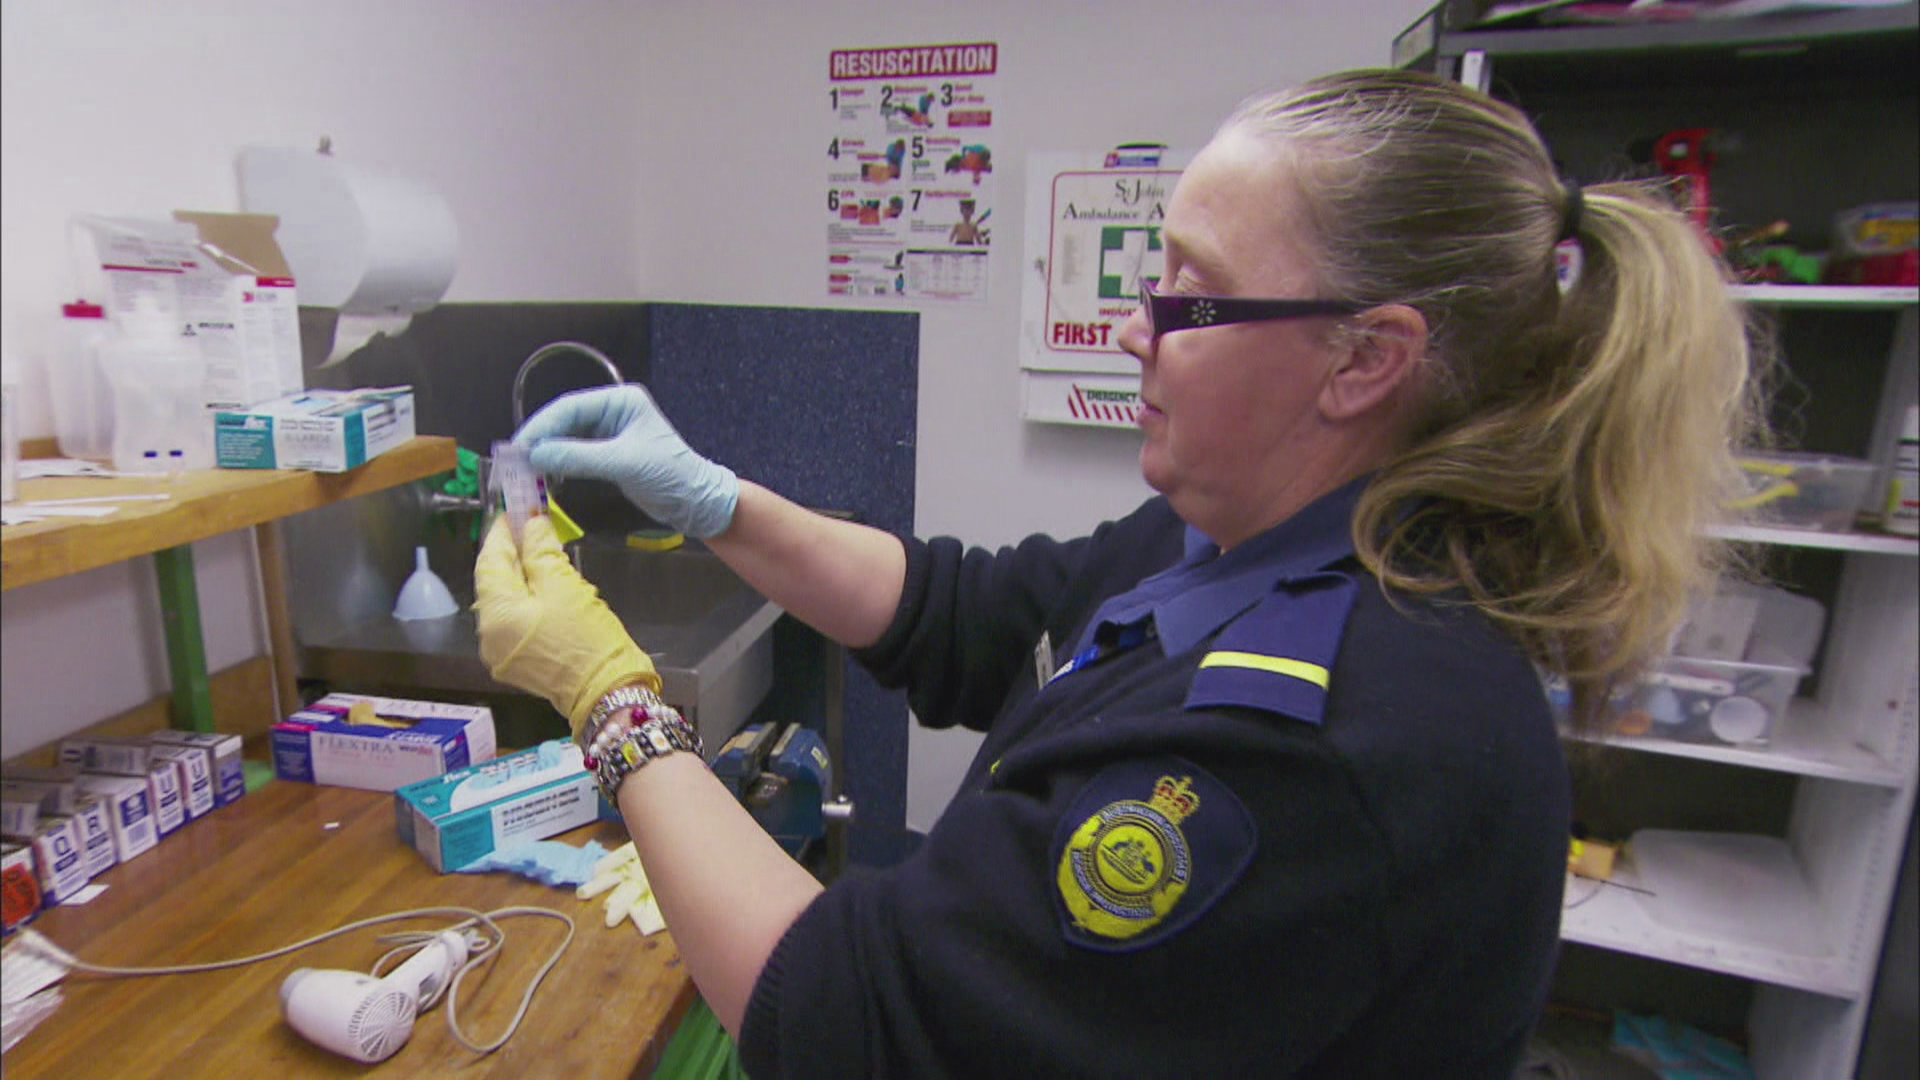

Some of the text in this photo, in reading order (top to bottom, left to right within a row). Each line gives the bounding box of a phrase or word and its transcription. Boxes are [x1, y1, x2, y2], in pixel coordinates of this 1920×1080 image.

[832, 45, 992, 77] RESUSCITATION
[830, 87, 838, 110] 1
[881, 85, 893, 110] 2
[941, 83, 953, 106] 3
[828, 138, 839, 160] 4
[912, 136, 924, 158] 5
[828, 189, 839, 211] 6
[911, 190, 922, 211] 7
[1063, 202, 1138, 220] Ambulance
[1053, 322, 1112, 345] FIRST
[319, 736, 394, 754] FLEXTRA
